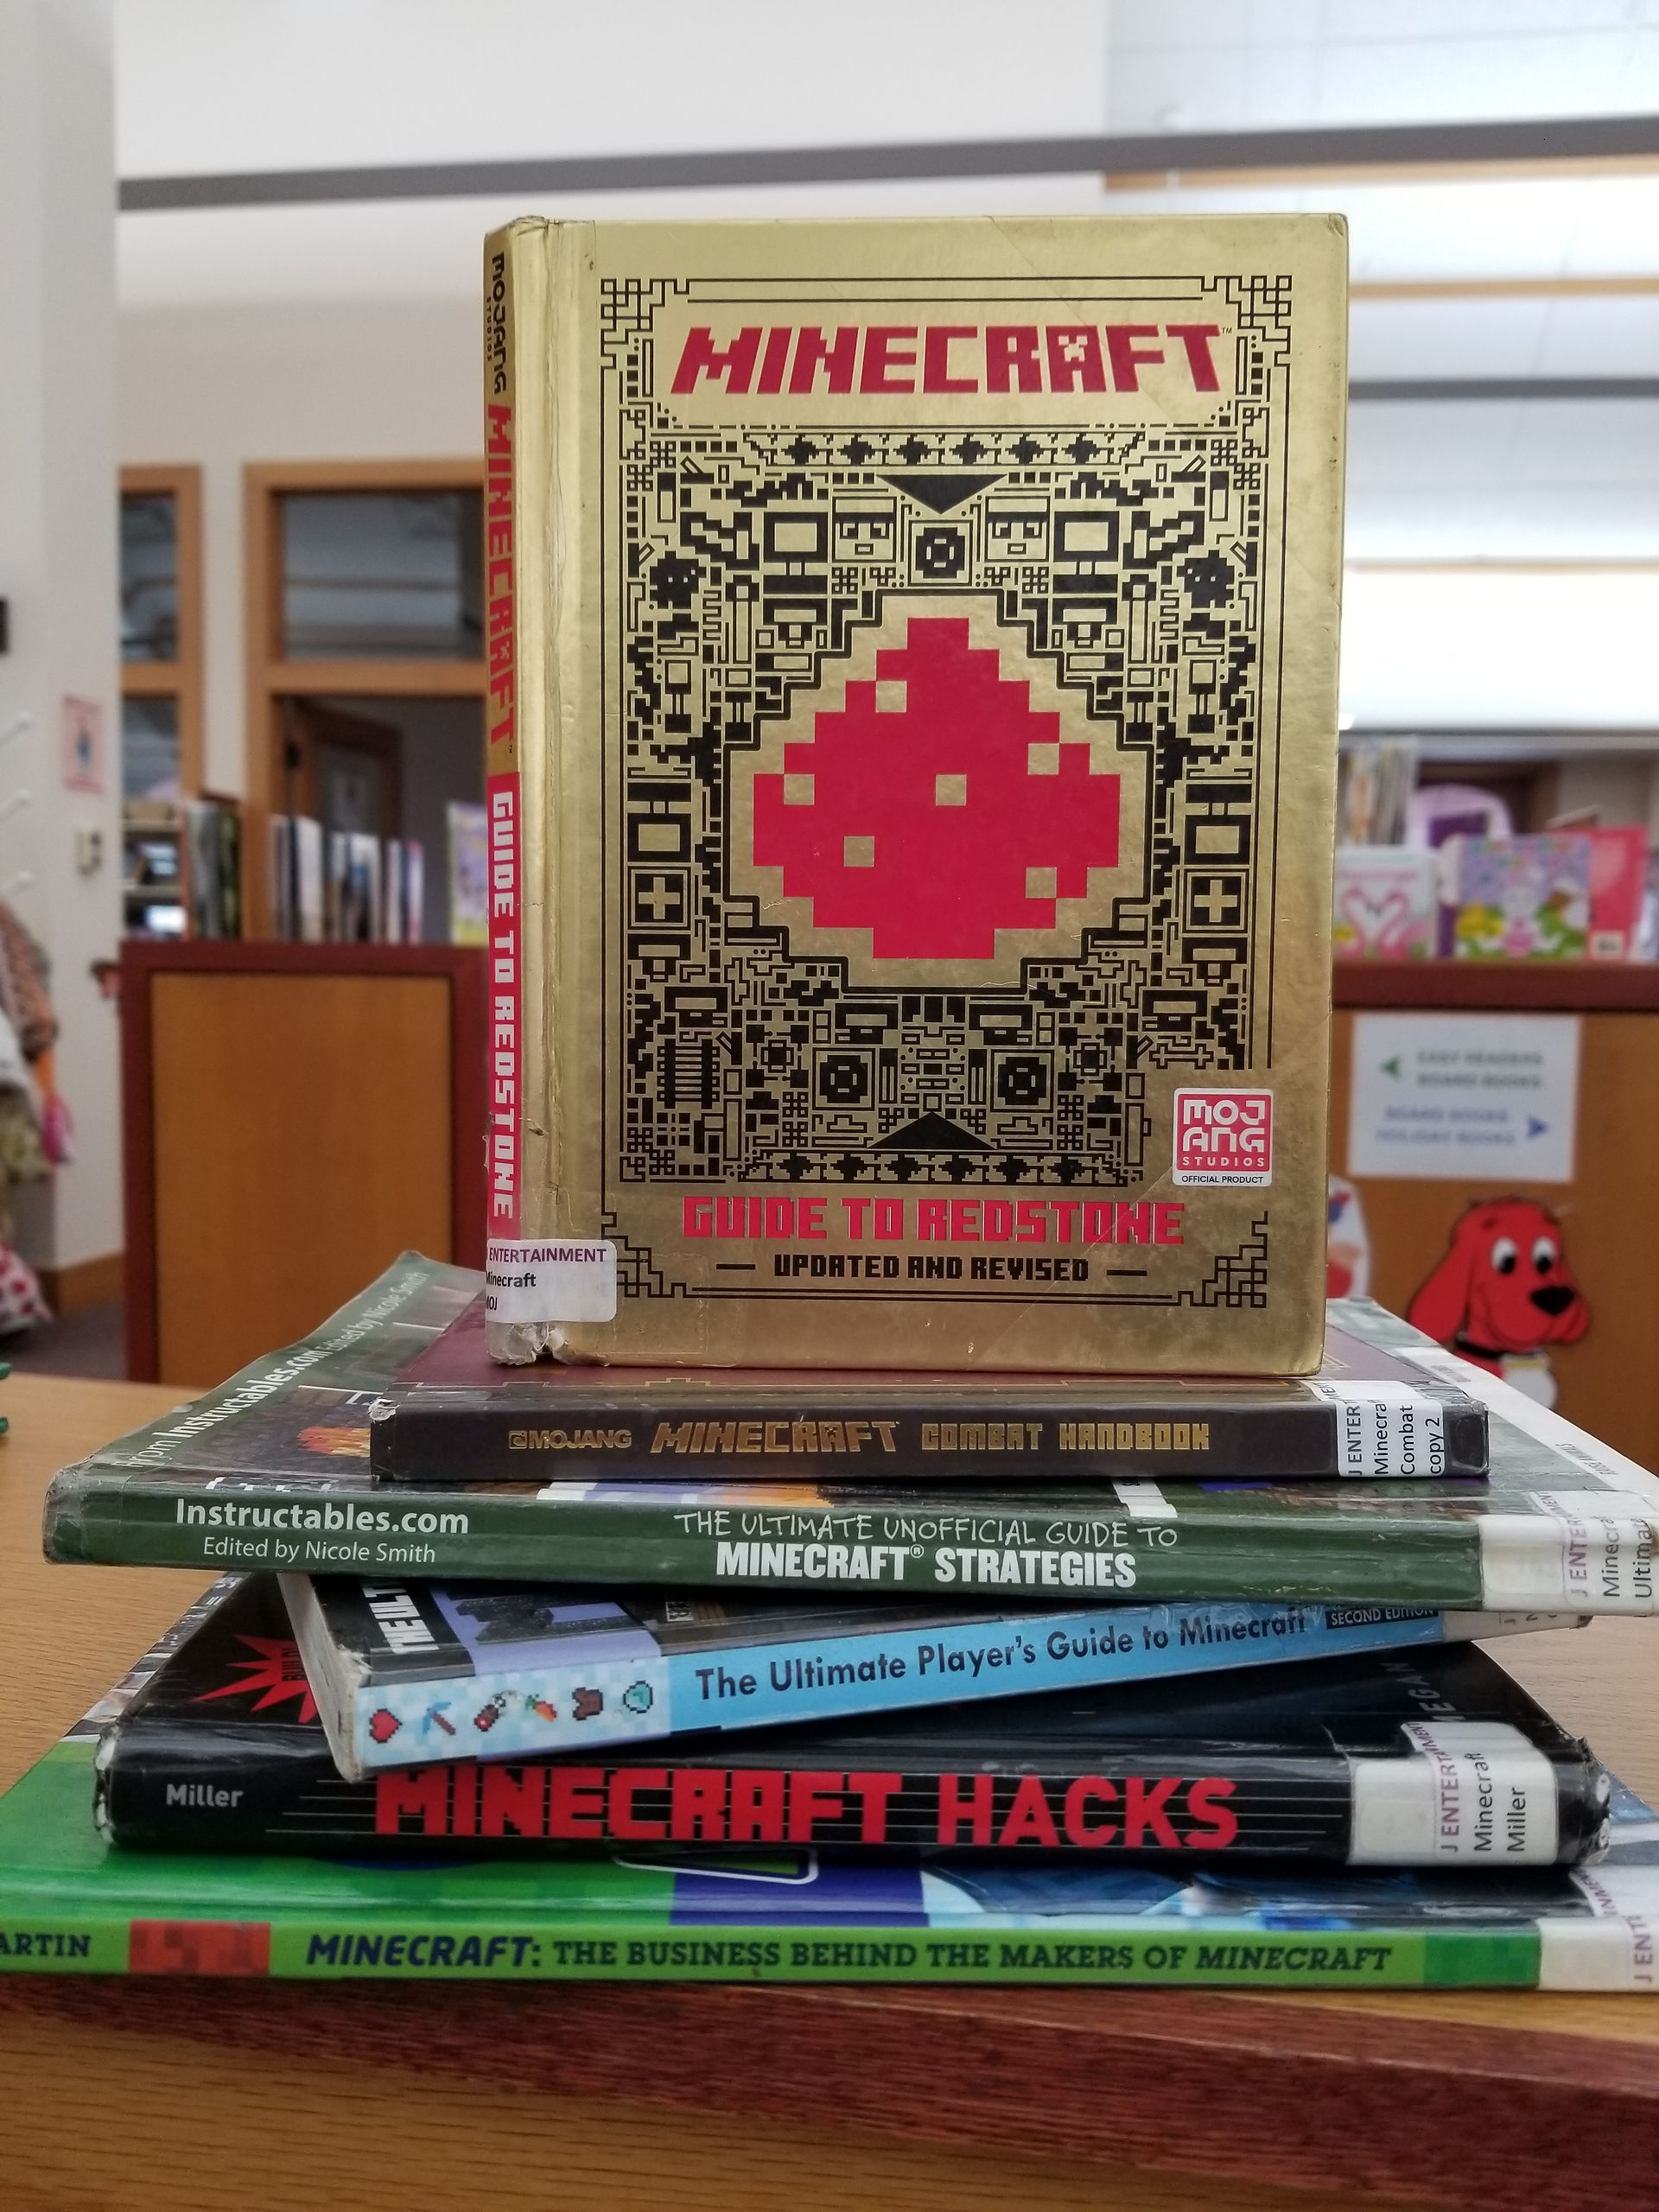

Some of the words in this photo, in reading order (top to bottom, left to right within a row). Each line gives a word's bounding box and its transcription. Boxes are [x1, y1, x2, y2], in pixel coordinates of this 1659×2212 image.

[493, 251, 506, 395] MOJANG
[671, 326, 1220, 395] MINECRAFT
[487, 404, 515, 745] MINECRAFT
[493, 791, 515, 918] GUIDE
[494, 930, 515, 983] TO
[493, 995, 516, 1219] REDSTONE
[1181, 1175, 1220, 1184] OFFICIAL
[1182, 1156, 1265, 1167] STUDIOS
[683, 1196, 828, 1239] GUIDE
[841, 1198, 904, 1240] TO
[917, 1199, 1185, 1244] REDSTONE
[489, 1247, 607, 1263] ENTERTAINMENT
[774, 1254, 899, 1278] UPDATED
[908, 1255, 963, 1279] AND
[970, 1257, 1090, 1281] REVISED
[168, 1348, 334, 1440] Instructables.com
[346, 1318, 384, 1330] by
[528, 1428, 632, 1450] MOJANG
[650, 1421, 898, 1453] MINECRAFT
[922, 1423, 1043, 1450] COMBAT
[1059, 1422, 1210, 1450] HANDBOOK
[1399, 1404, 1415, 1475] Combat
[1425, 1417, 1440, 1427] 2
[1428, 1433, 1445, 1474] copy
[176, 1498, 469, 1535] Instructables.com
[674, 1510, 732, 1538] THE
[741, 1513, 874, 1541] ULTIMATE
[883, 1517, 1037, 1546] UNOFFICIAL
[1046, 1520, 1128, 1548] GUIDE
[1138, 1526, 1178, 1547] TO
[204, 1536, 269, 1558] Edited
[276, 1540, 301, 1564] by
[305, 1541, 371, 1561] Nicole
[376, 1542, 435, 1563] Smith
[934, 1548, 1137, 1588] STRATEGIES
[1331, 1607, 1381, 1626] SECOND
[695, 1667, 758, 1700] The
[770, 1653, 907, 1693] Ultimate
[918, 1635, 1037, 1678] Player's
[1047, 1624, 1134, 1660] Guide
[1142, 1622, 1170, 1651] to
[1179, 1606, 1306, 1646] Minecraft
[166, 1784, 245, 1807] Miller
[375, 1764, 901, 1845] MINECRAFT
[938, 1772, 1239, 1851] HACKS
[1464, 1752, 1493, 1852] Minecraft
[1507, 1787, 1527, 1852] Miller
[1440, 1844, 1459, 1853] J
[306, 1934, 542, 1968] MINECRAFT:
[553, 1941, 617, 1966] THE
[627, 1941, 779, 1967] BUSINESS
[790, 1942, 917, 1967] BEHIND
[926, 1943, 989, 1968] THE
[999, 1944, 1135, 1970] MAKERS
[1143, 1945, 1188, 1971] OF
[1194, 1946, 1393, 1972] MINECRAFT
